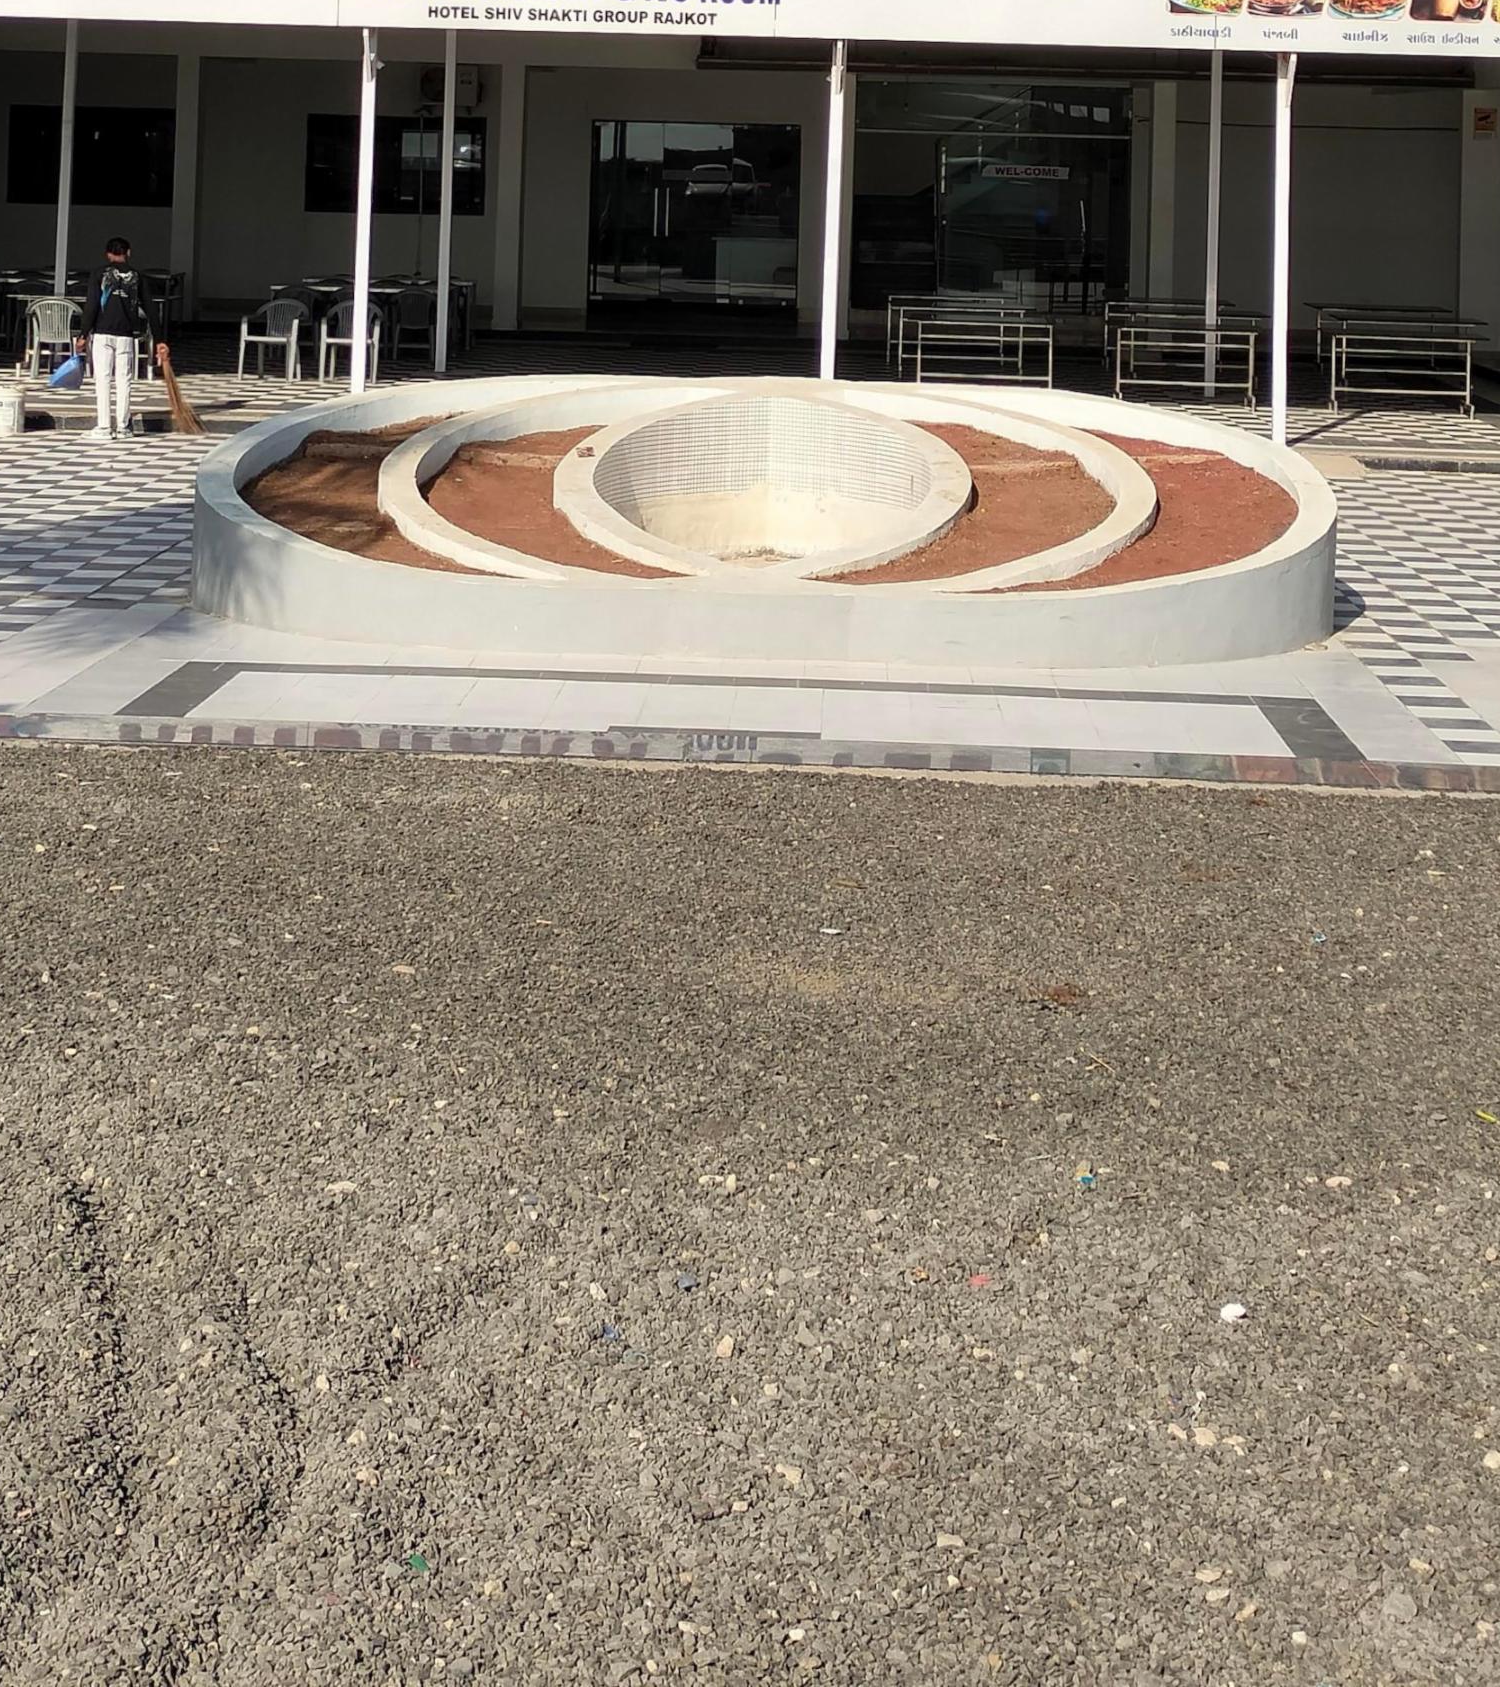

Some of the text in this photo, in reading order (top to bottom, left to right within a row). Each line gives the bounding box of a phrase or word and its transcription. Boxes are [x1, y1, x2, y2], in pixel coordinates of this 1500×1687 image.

[428, 6, 717, 25] HOTEL SHIV SHAKTI GROUP RAJKOT
[1263, 27, 1298, 40] પંજાબી
